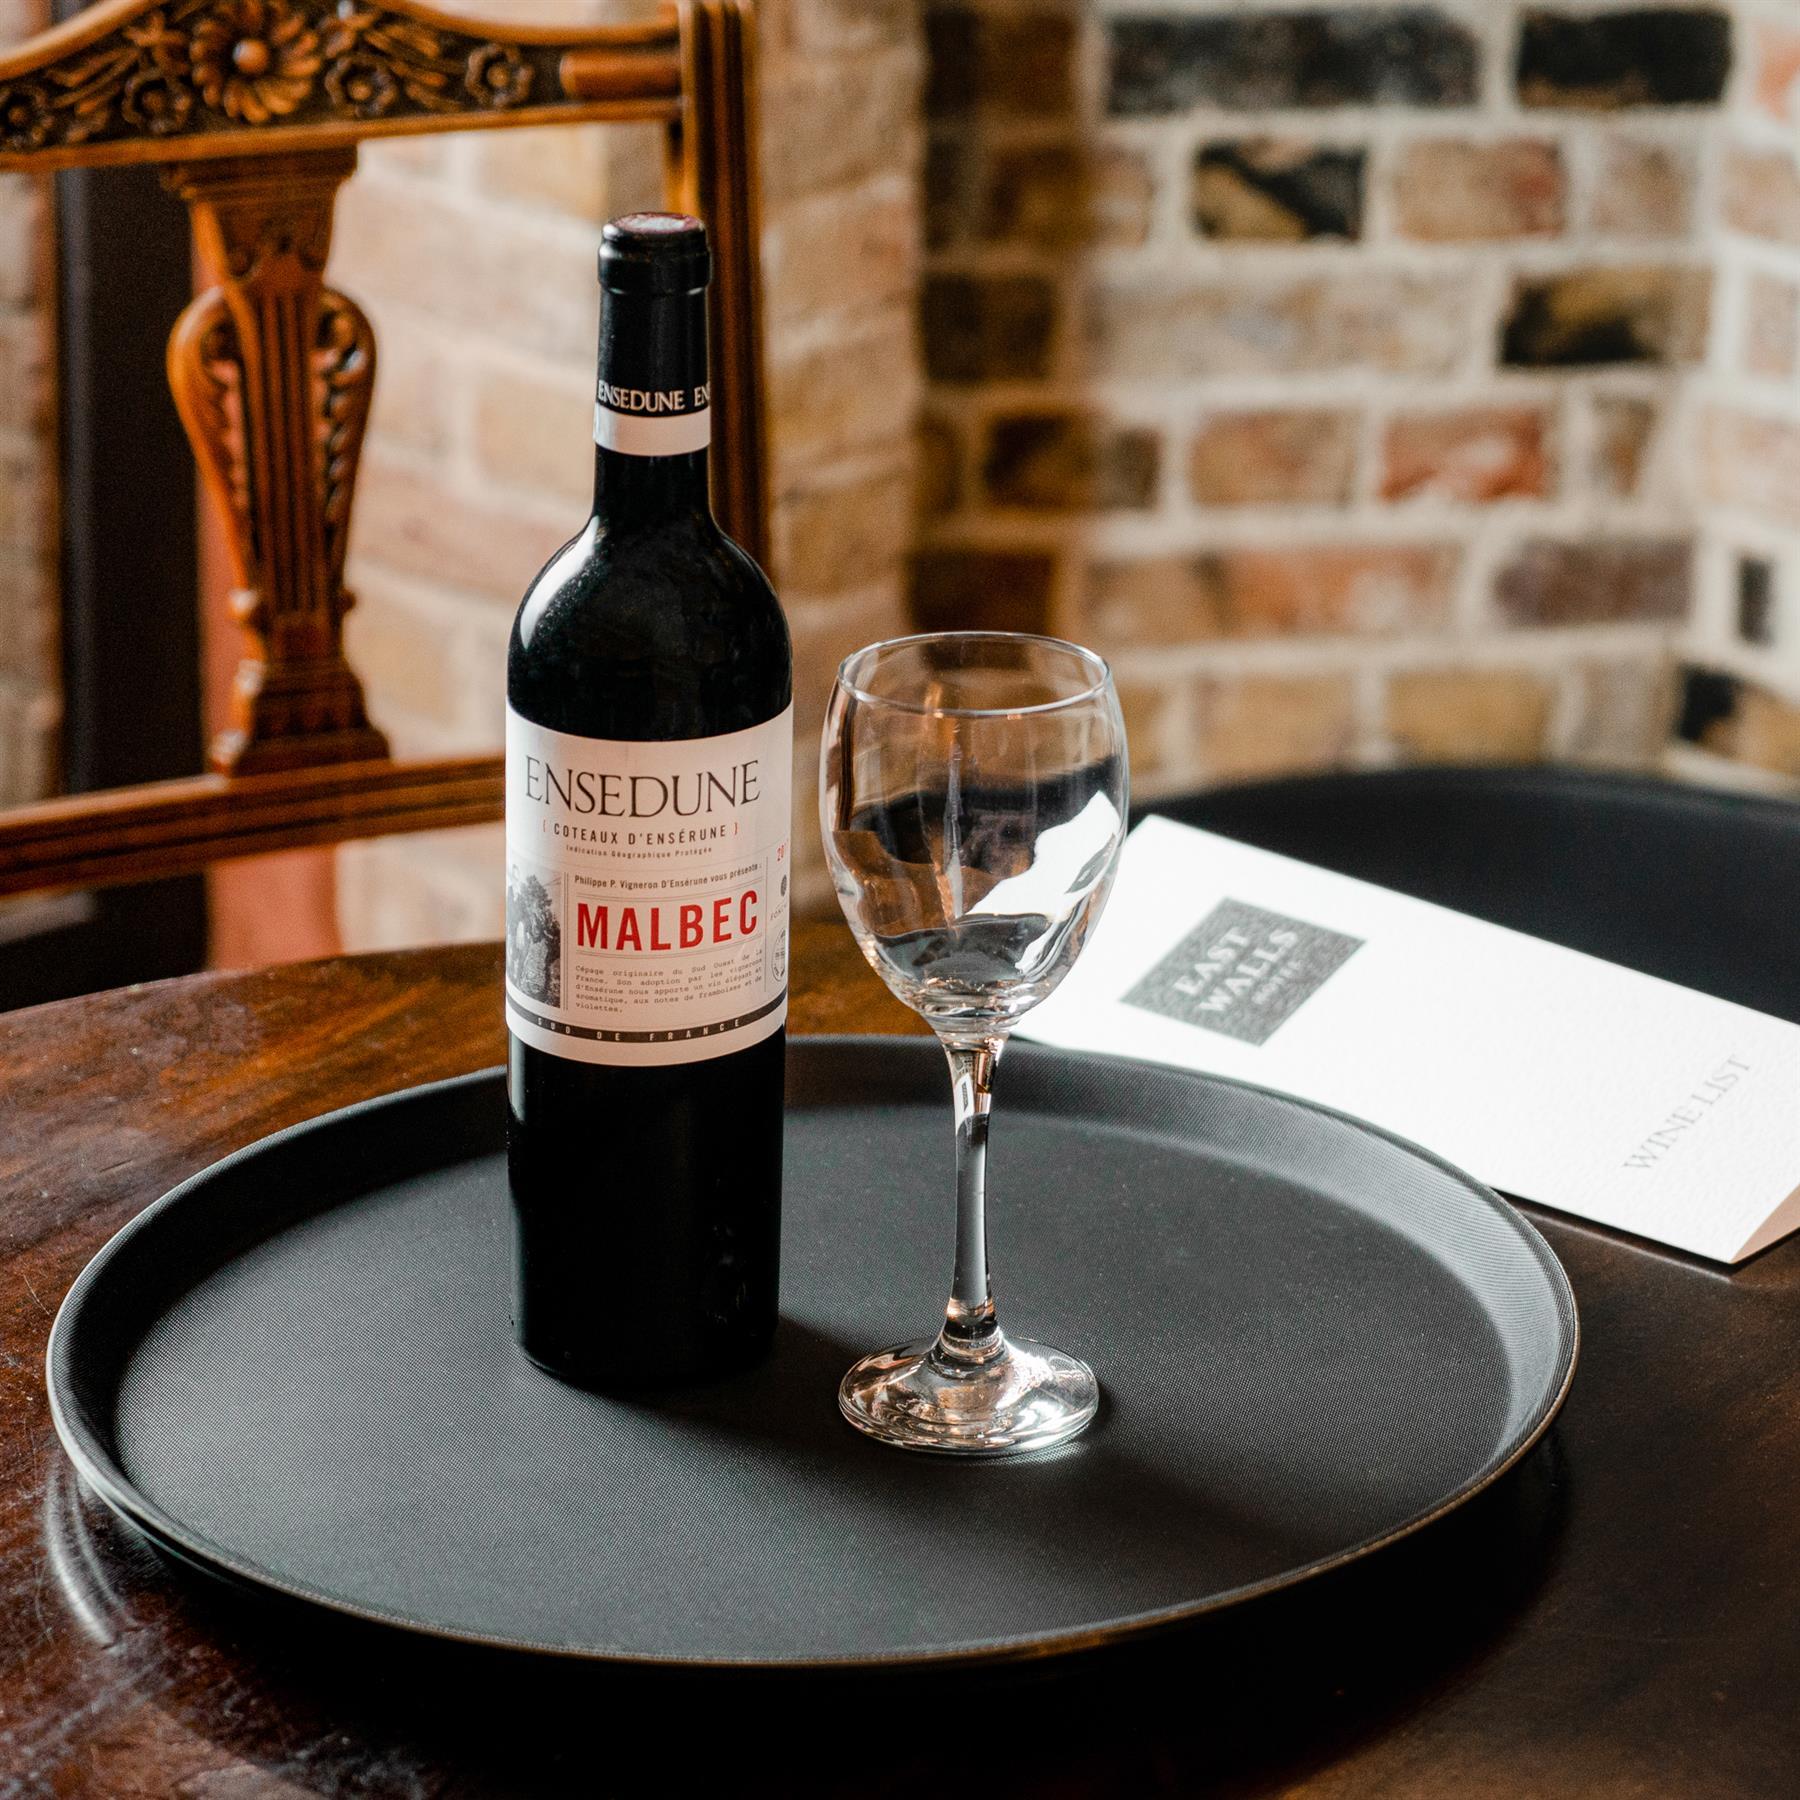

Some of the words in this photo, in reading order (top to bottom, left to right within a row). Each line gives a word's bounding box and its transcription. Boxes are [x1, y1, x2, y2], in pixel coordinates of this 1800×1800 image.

[597, 380, 685, 412] ENSEDUNE
[526, 755, 761, 817] ENSEDUNE
[554, 823, 618, 844] COTEAUX
[628, 825, 726, 845] D'ENSÉRUNE
[566, 844, 607, 857] Indication
[611, 850, 671, 860] Géographique
[575, 874, 607, 888] Philippe
[610, 879, 617, 888] P.
[620, 880, 658, 890] Vigneron
[661, 878, 708, 888] D'Ensérune
[710, 872, 728, 882] vous
[577, 889, 758, 952] MALBEC
[575, 965, 604, 976] Cépage
[612, 970, 664, 978] originaire
[691, 965, 706, 973] Sud
[713, 959, 735, 969] Ouest
[1173, 926, 1250, 996] EAST
[1197, 928, 1299, 1012] WALLS
[575, 974, 608, 985] France.
[640, 978, 681, 986] adoption
[688, 975, 702, 983] par
[711, 971, 723, 979] les
[575, 984, 624, 994] d'Ensérune
[654, 986, 689, 996] apporte
[576, 994, 628, 1005] aromatique,
[654, 996, 679, 1004] notes
[699, 984, 741, 999] framboises
[537, 1017, 571, 1034] SUD
[596, 1031, 620, 1041] DE
[650, 1018, 739, 1041] FRANCE
[1622, 1105, 1704, 1169] WINE
[1690, 1053, 1750, 1106] LIST
